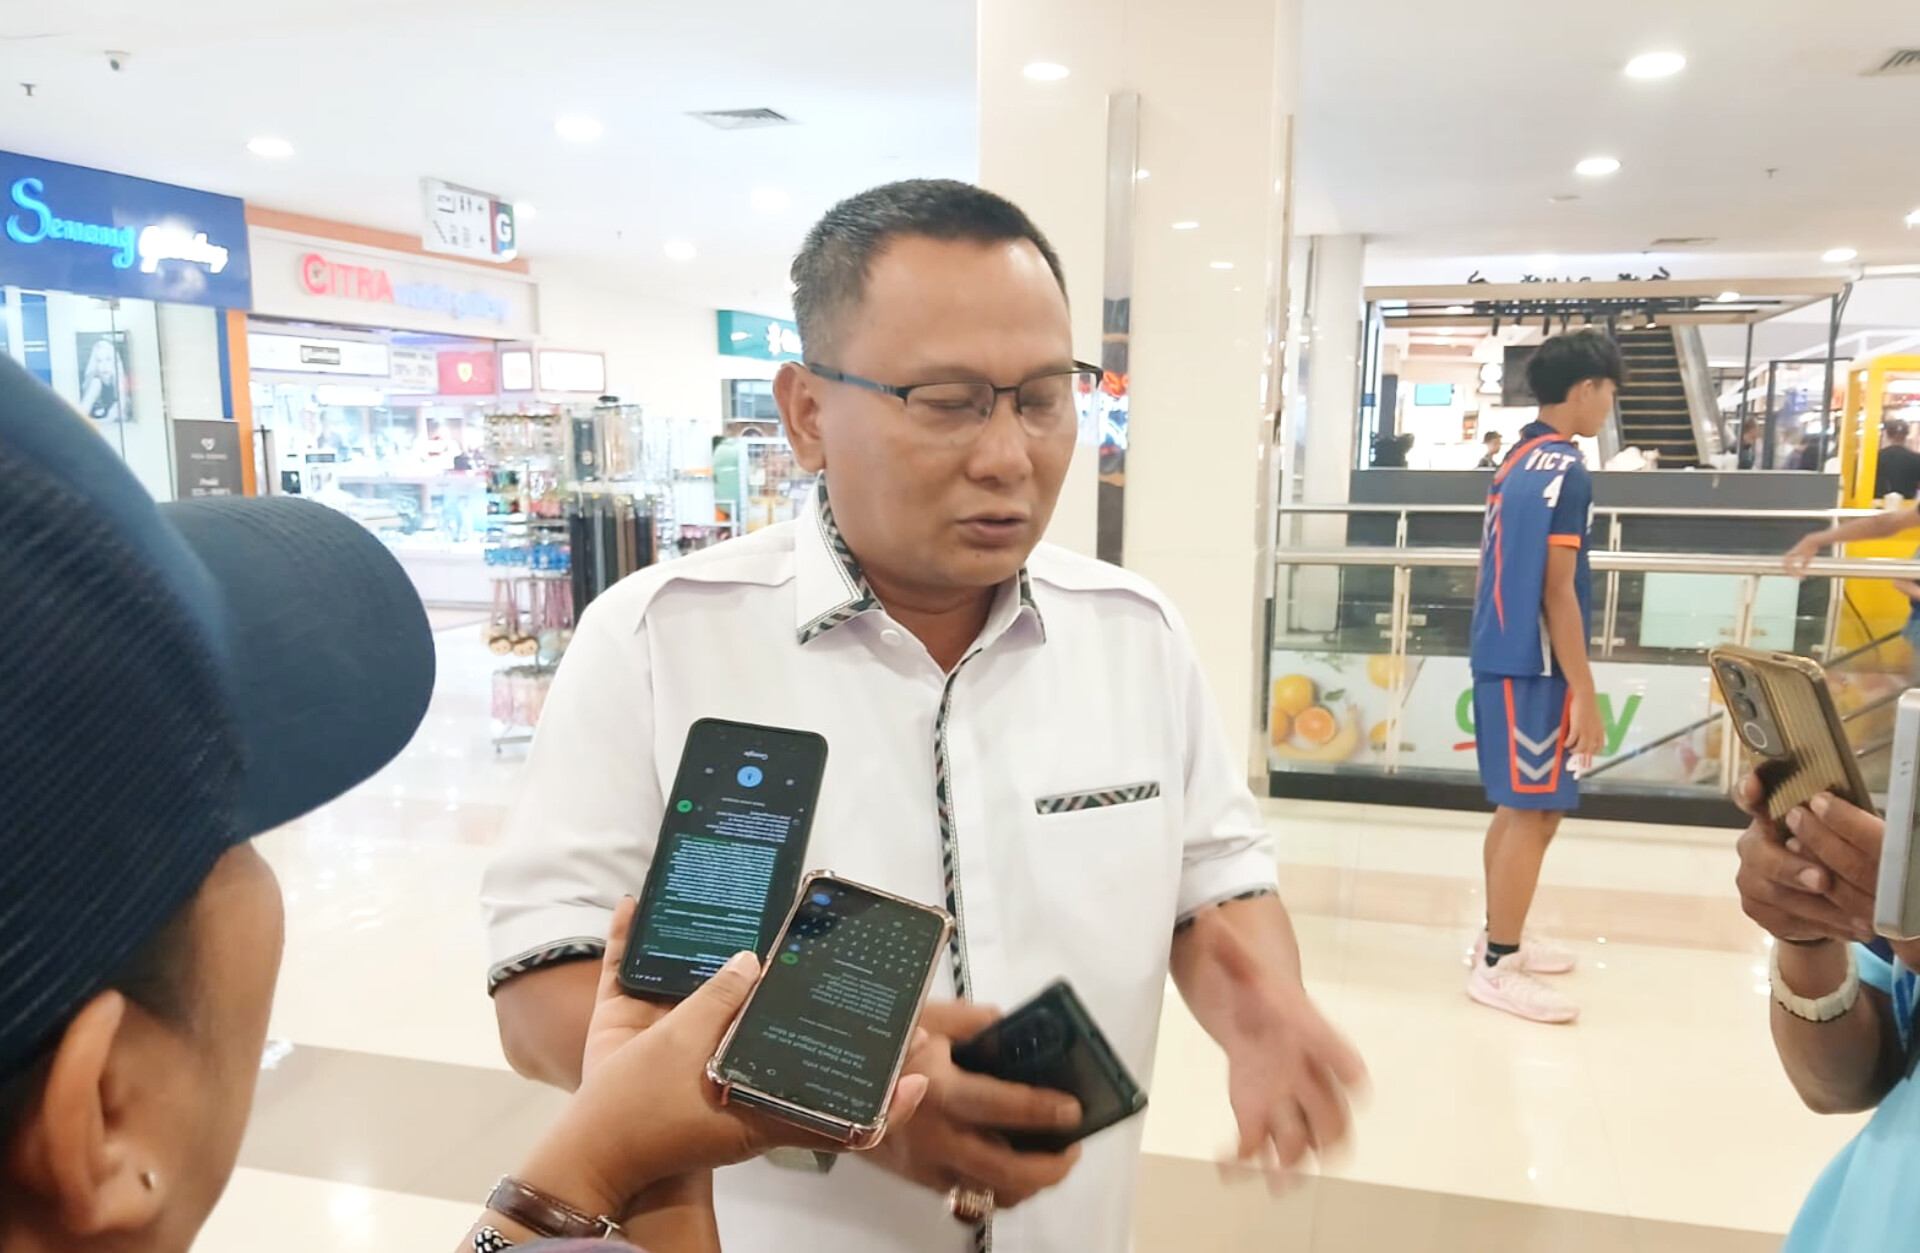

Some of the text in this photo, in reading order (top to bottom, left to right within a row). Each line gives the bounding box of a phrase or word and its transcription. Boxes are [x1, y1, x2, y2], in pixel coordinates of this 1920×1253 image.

[496, 213, 513, 243] G
[301, 253, 395, 303] CITRA
[1543, 475, 1565, 508] 4
